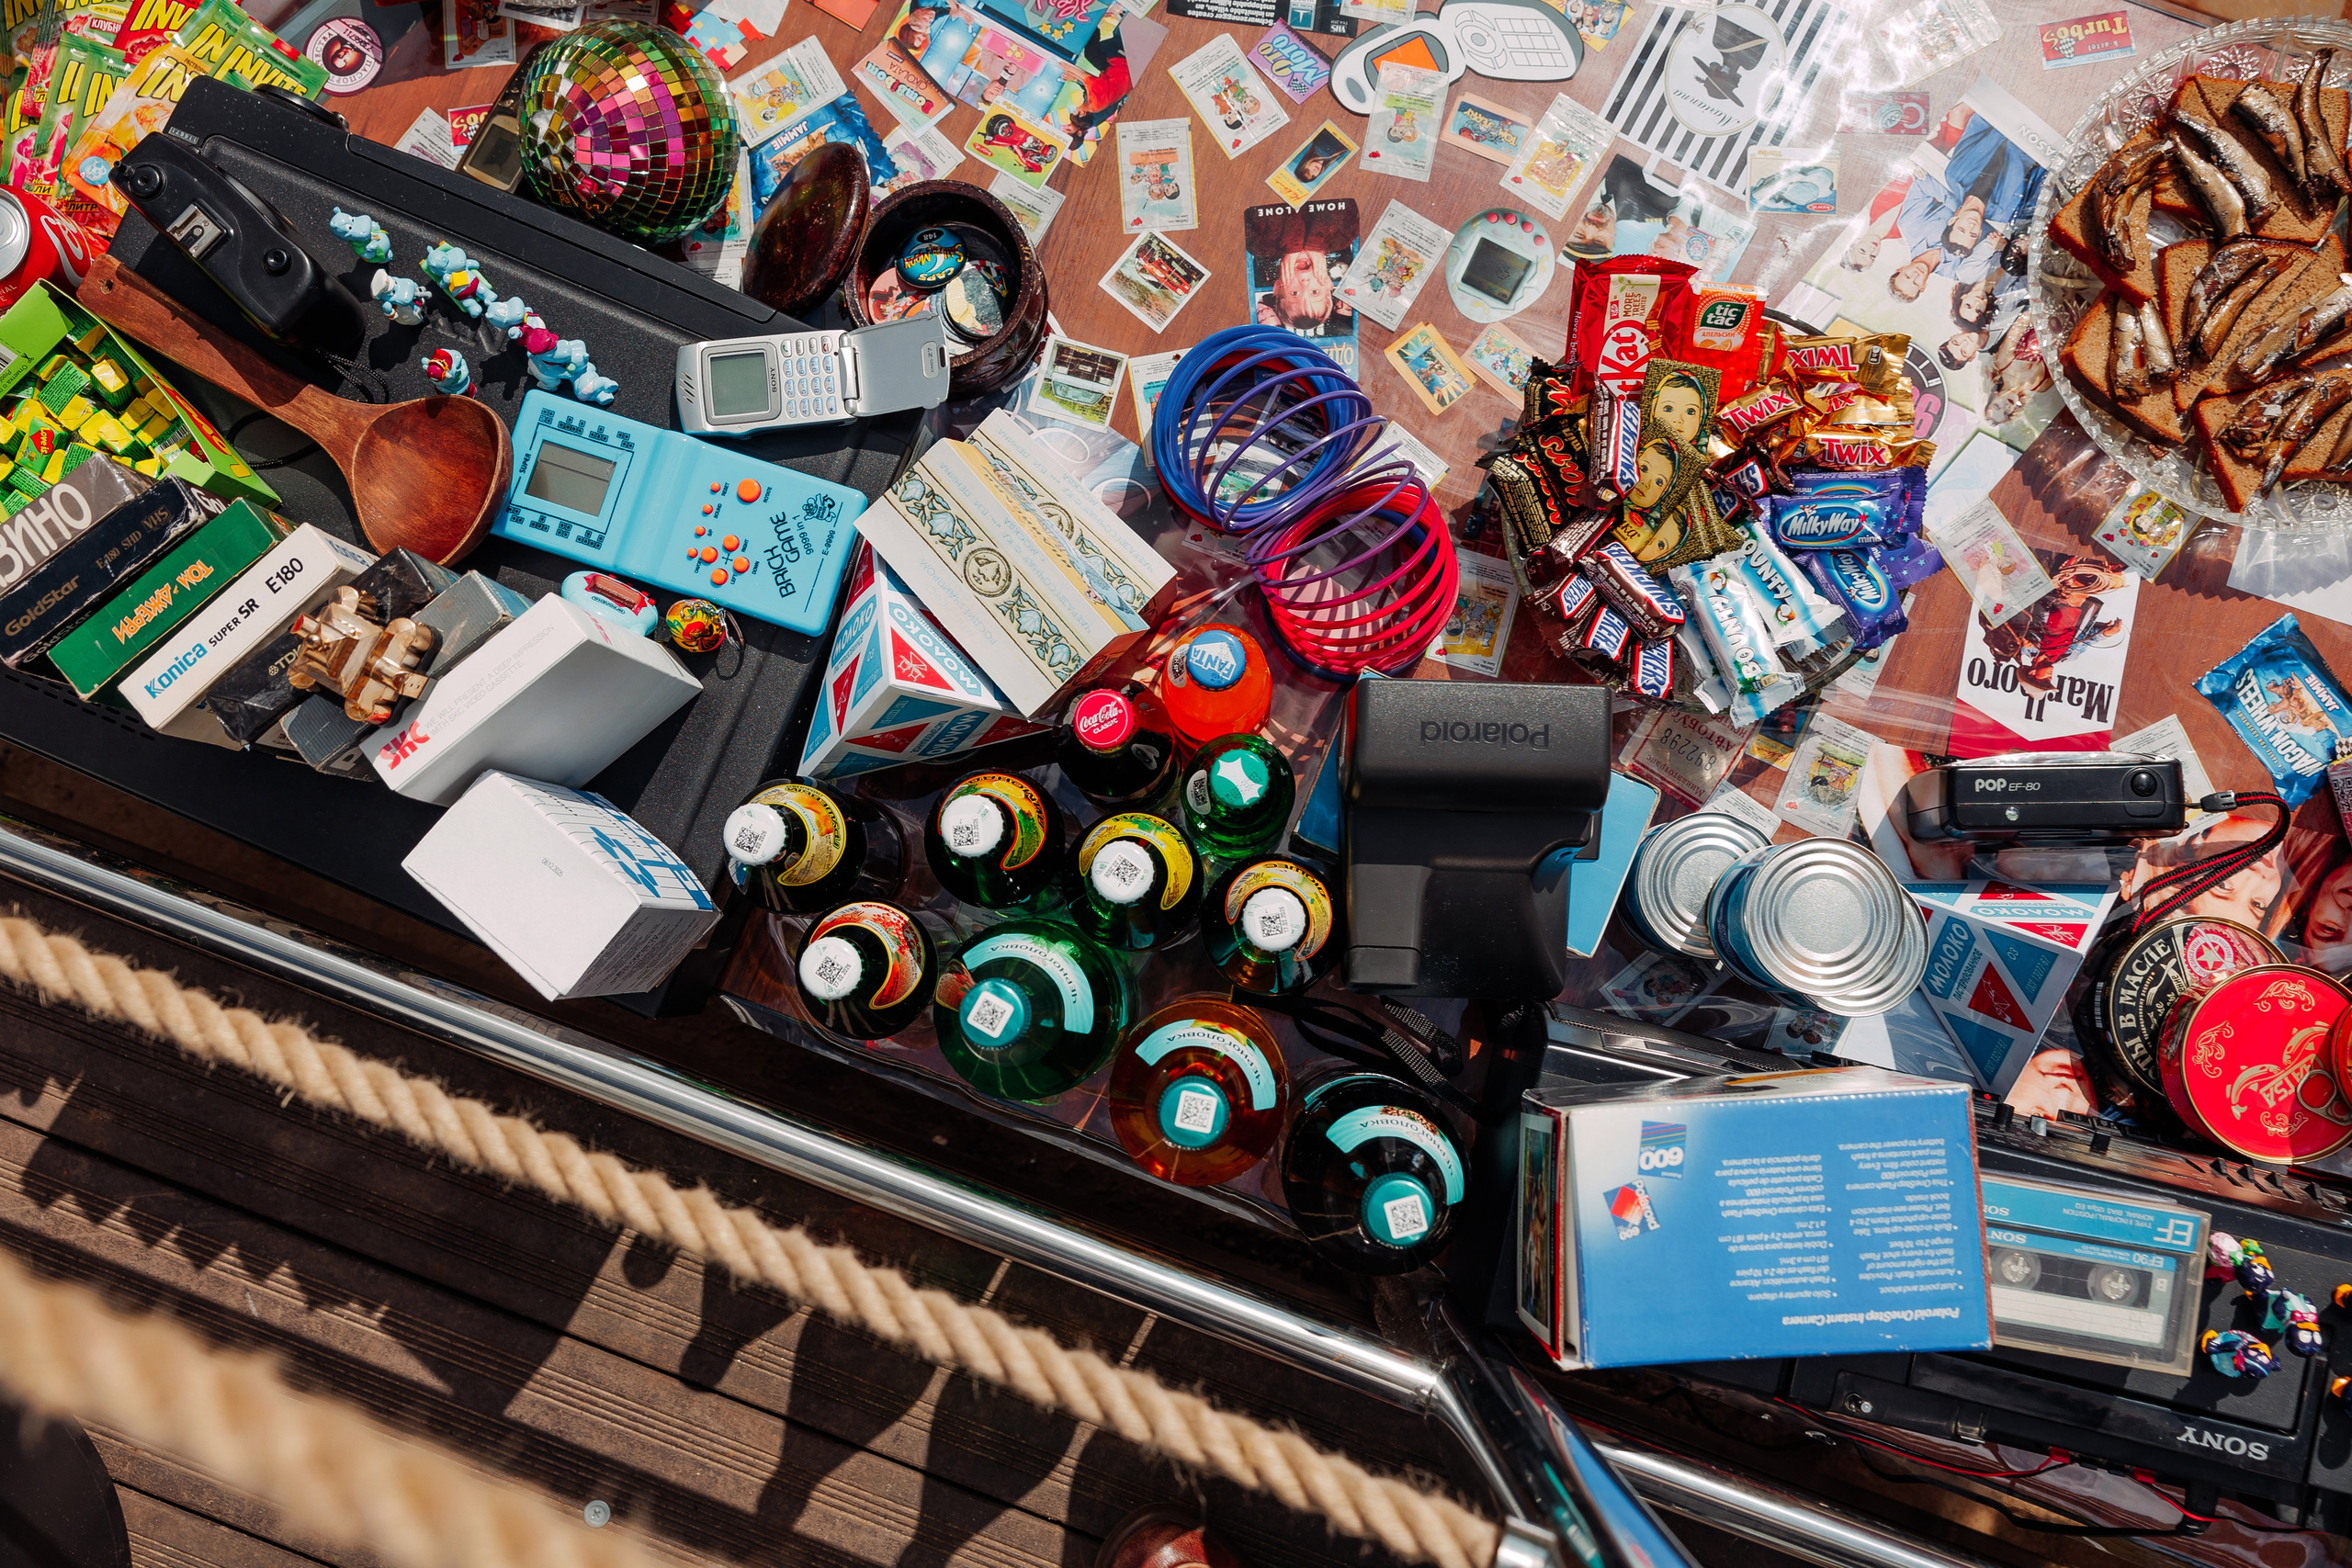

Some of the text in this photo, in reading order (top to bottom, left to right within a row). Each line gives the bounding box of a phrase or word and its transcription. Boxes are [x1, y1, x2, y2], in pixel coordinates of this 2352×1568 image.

[1187, 10, 1214, 18] creates
[1230, 8, 1264, 17] inimitable
[1233, 2, 1275, 10] unstoppable
[1330, 24, 1348, 34] VHS
[2056, 16, 2128, 42] Turbo
[1258, 42, 1295, 79] OTO
[1272, 34, 1330, 87] MOTO
[1001, 99, 1023, 118] Turbo
[772, 120, 809, 152] JAMMIE
[1462, 107, 1519, 148] TOM JERRY
[1308, 200, 1347, 213] HOME
[922, 231, 939, 242] 148
[903, 249, 933, 270] MOON
[917, 265, 956, 283] CAPS
[1623, 292, 1632, 317] MORE
[1632, 293, 1642, 317] TREES
[1639, 296, 1647, 317] PLANTED
[1715, 303, 1738, 318] tic
[1573, 310, 1582, 333] Have
[1706, 313, 1736, 327] tac
[1701, 330, 1736, 339] АПЕЛЬСИН
[770, 366, 778, 394] SONY
[997, 427, 1031, 459] ЛЕНИНА
[519, 453, 532, 474] SUPER
[721, 482, 730, 496] RESET
[763, 486, 772, 503] ROTATE
[1062, 473, 1098, 505] МОСКВА
[714, 503, 722, 519] SOUND
[770, 512, 800, 563] GAME
[797, 522, 814, 555] 9999 in
[822, 530, 836, 556] E-9999
[5, 575, 80, 637] GoldStar
[120, 530, 142, 551] SHD
[142, 506, 171, 530] VHS
[752, 560, 760, 575] DOWN
[763, 545, 797, 598] BRICK
[110, 558, 215, 646] ТОМ ДЖЕРРИ
[143, 557, 305, 700] Konica SUPER SR E180
[832, 599, 875, 660] МОЛОКО
[1708, 594, 1764, 679] BOUNTY
[892, 605, 980, 690] МОЛОКО
[910, 609, 978, 676] ПАСТЕРИЗОВАННОЕ
[453, 678, 487, 707] PRESENT
[493, 657, 512, 676] DEEP
[514, 624, 555, 660] IMPRESSION
[1191, 647, 1234, 681] FANTA
[2304, 672, 2341, 712] JAMMIE
[430, 717, 450, 738] WITH
[449, 706, 465, 722] SKC
[463, 688, 486, 714] VIDEO
[2234, 668, 2327, 778] WAGON WHEELS
[2235, 710, 2259, 739] ADVENTURE
[927, 713, 980, 757] МОЛОКО
[1092, 718, 1119, 735] CLASSIC
[1419, 719, 1550, 751] Polaroid
[1659, 727, 1717, 773] 892298
[1974, 778, 2041, 793] POP EF-80
[752, 829, 768, 855] 10.02.2026
[1103, 854, 1124, 878] 27.02.2026
[1976, 906, 2085, 919] МОЛОКО
[1930, 922, 1970, 994] МОЛОКО
[831, 963, 852, 988] 27.02.2026
[989, 943, 1079, 1005] ЧЕРНОГОЛОВКА
[1952, 947, 1984, 1002] ПАСТЕРИЗОВАННОЕ
[2119, 938, 2172, 1030] В МАСЛЕ
[1166, 1032, 1262, 1087] ЧЕРНОГОЛОВКА
[1360, 1117, 1455, 1177] ЧЕРНОГОЛОВКА
[1638, 1145, 1685, 1171] 600
[1880, 1168, 1947, 1179] uses Polaroid 600
[1632, 1179, 1661, 1232] Polaroid
[2062, 1208, 2094, 1221] POSITION
[2075, 1201, 2154, 1222] NORMAL BIAS EQ
[1619, 1225, 1641, 1241] 600
[2137, 1220, 2153, 1230] TYPE
[2152, 1218, 2195, 1247] EF
[2154, 1278, 2167, 1293] B
[1781, 1305, 1960, 1327] Polaroid OneStep Instant Camera
[2176, 1426, 2270, 1461] SONY
